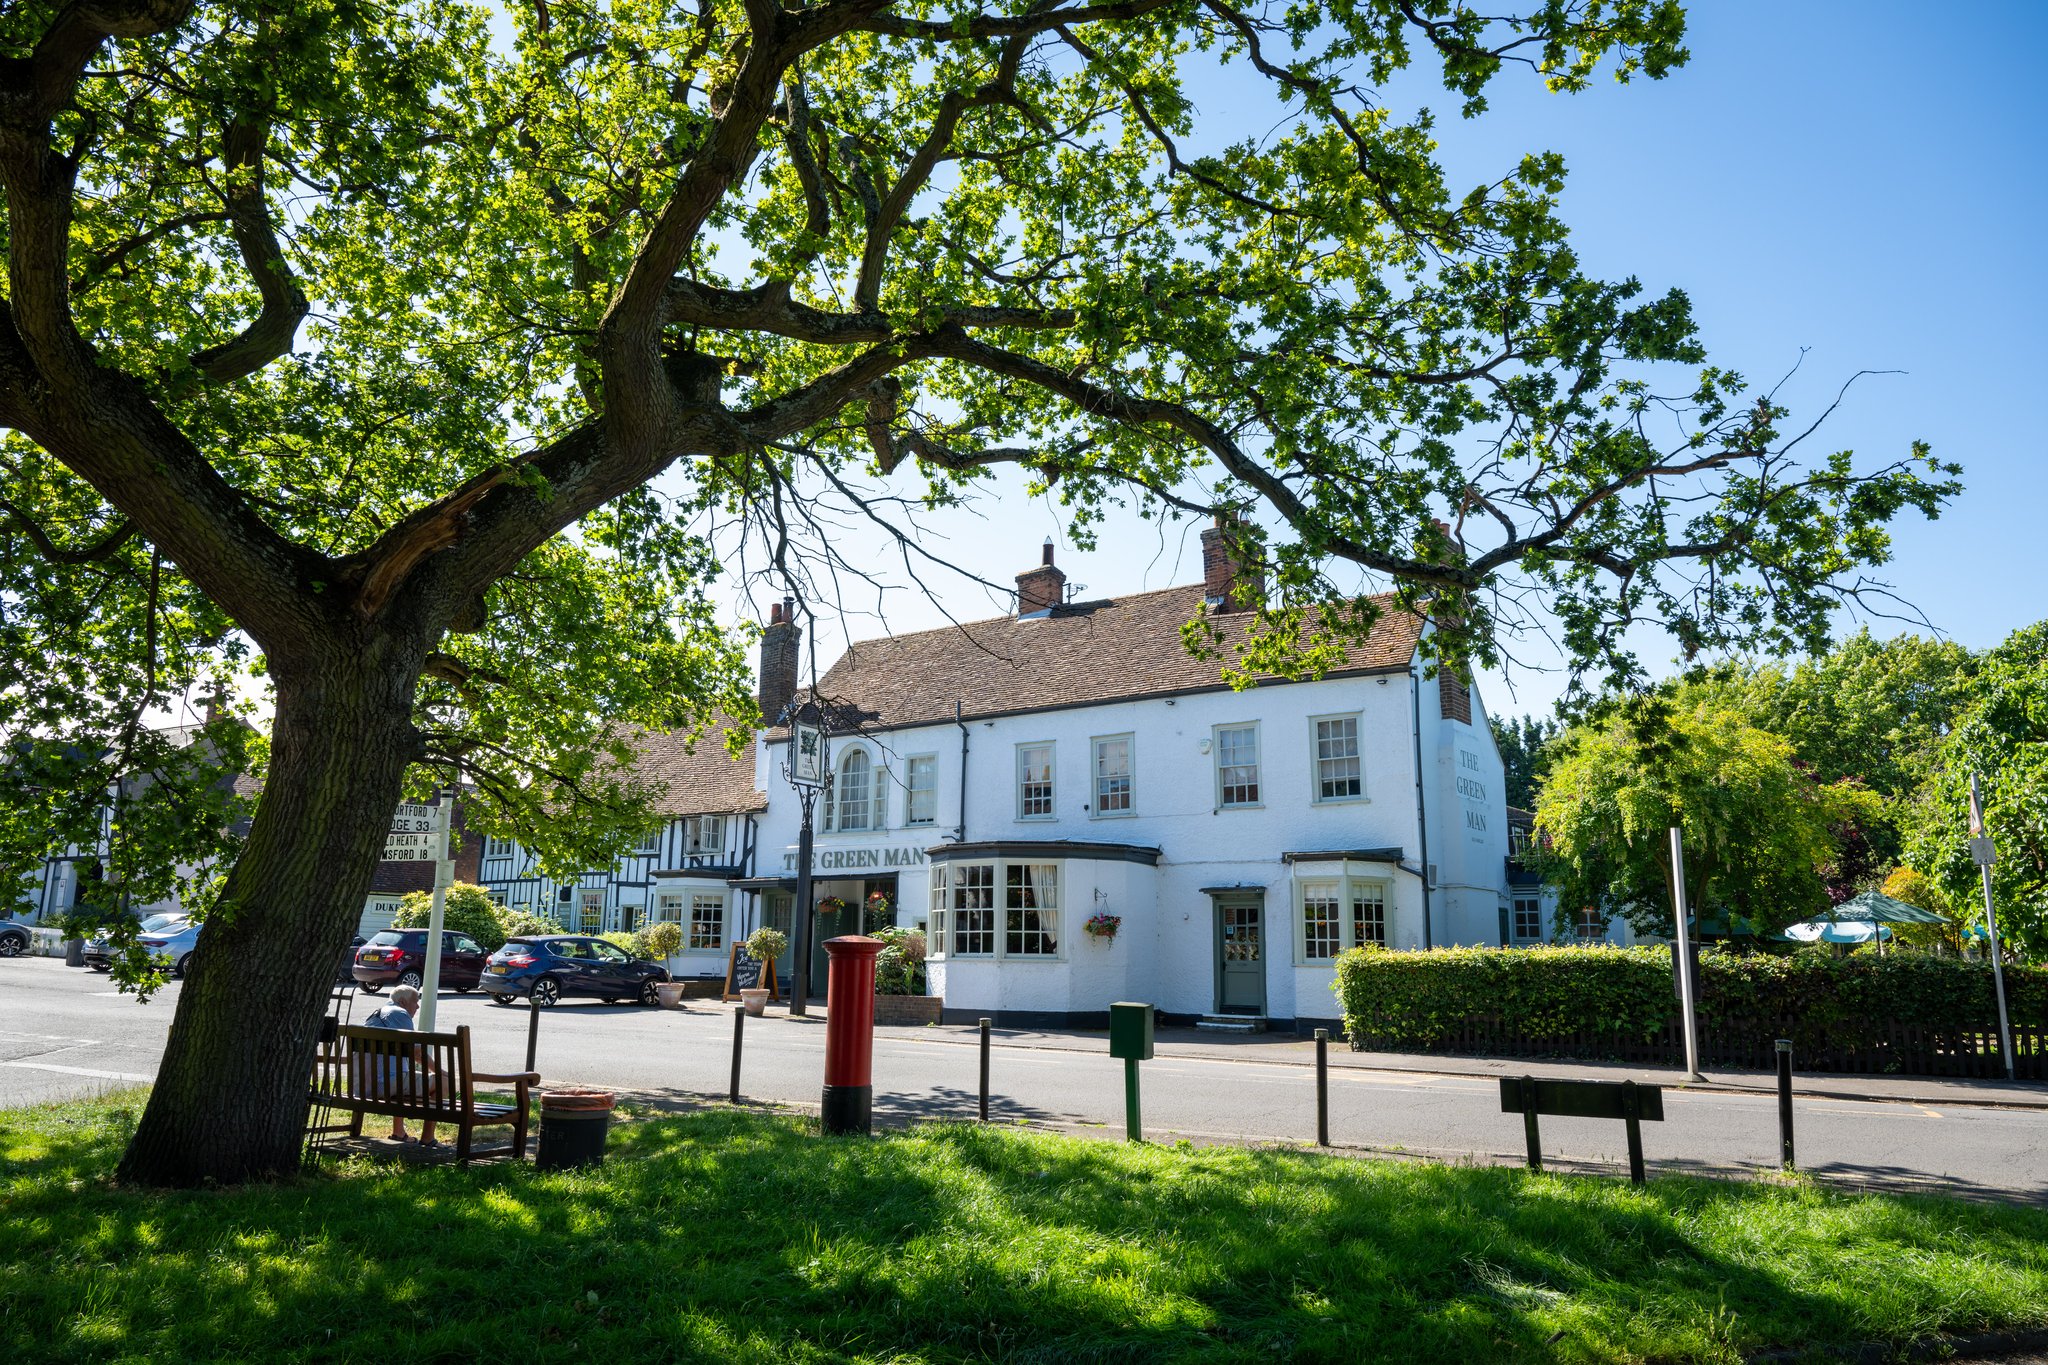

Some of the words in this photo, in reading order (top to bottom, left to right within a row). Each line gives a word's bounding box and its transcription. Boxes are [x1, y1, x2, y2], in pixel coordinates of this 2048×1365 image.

[1460, 749, 1479, 772] THE
[1456, 776, 1486, 801] GREEN
[433, 807, 438, 818] 7
[1466, 810, 1486, 832] MAN
[416, 820, 430, 832] 33
[396, 835, 418, 846] HEATH
[423, 835, 428, 846] 4
[420, 849, 428, 860] 18
[821, 849, 880, 869] GREEN
[884, 847, 926, 867] MAN
